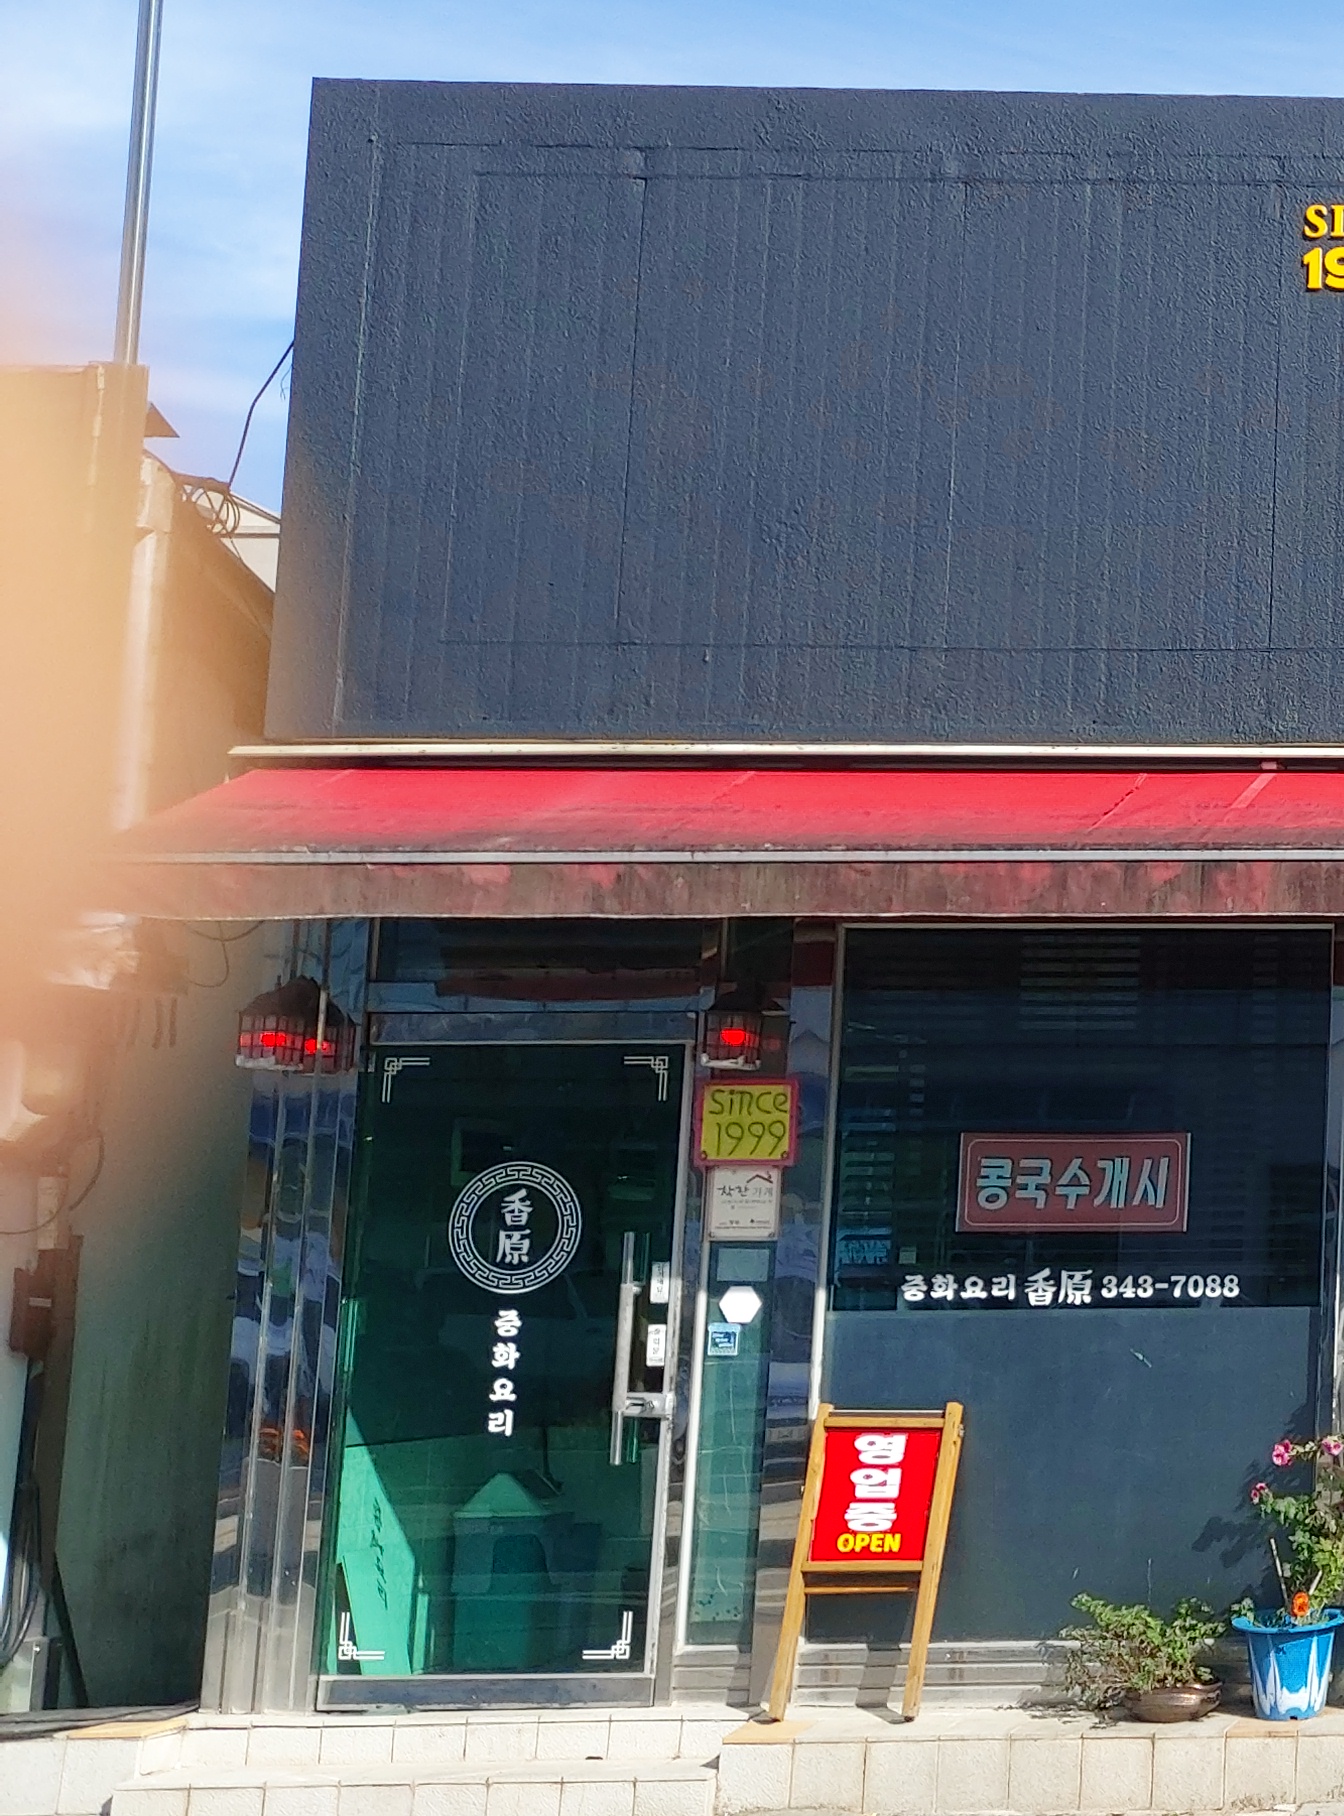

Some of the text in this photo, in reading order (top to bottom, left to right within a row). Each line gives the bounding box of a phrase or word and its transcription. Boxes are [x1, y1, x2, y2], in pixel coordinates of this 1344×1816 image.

[716, 1121, 786, 1156] 1999
[976, 1157, 1169, 1210] 콩국수개시
[496, 1188, 533, 1265] 香原
[901, 1267, 1241, 1306] 중화요리 香原 343-7088
[487, 1309, 523, 1437] 중화요리
[844, 1432, 908, 1532] 영업중
[836, 1533, 902, 1553] OPEN
